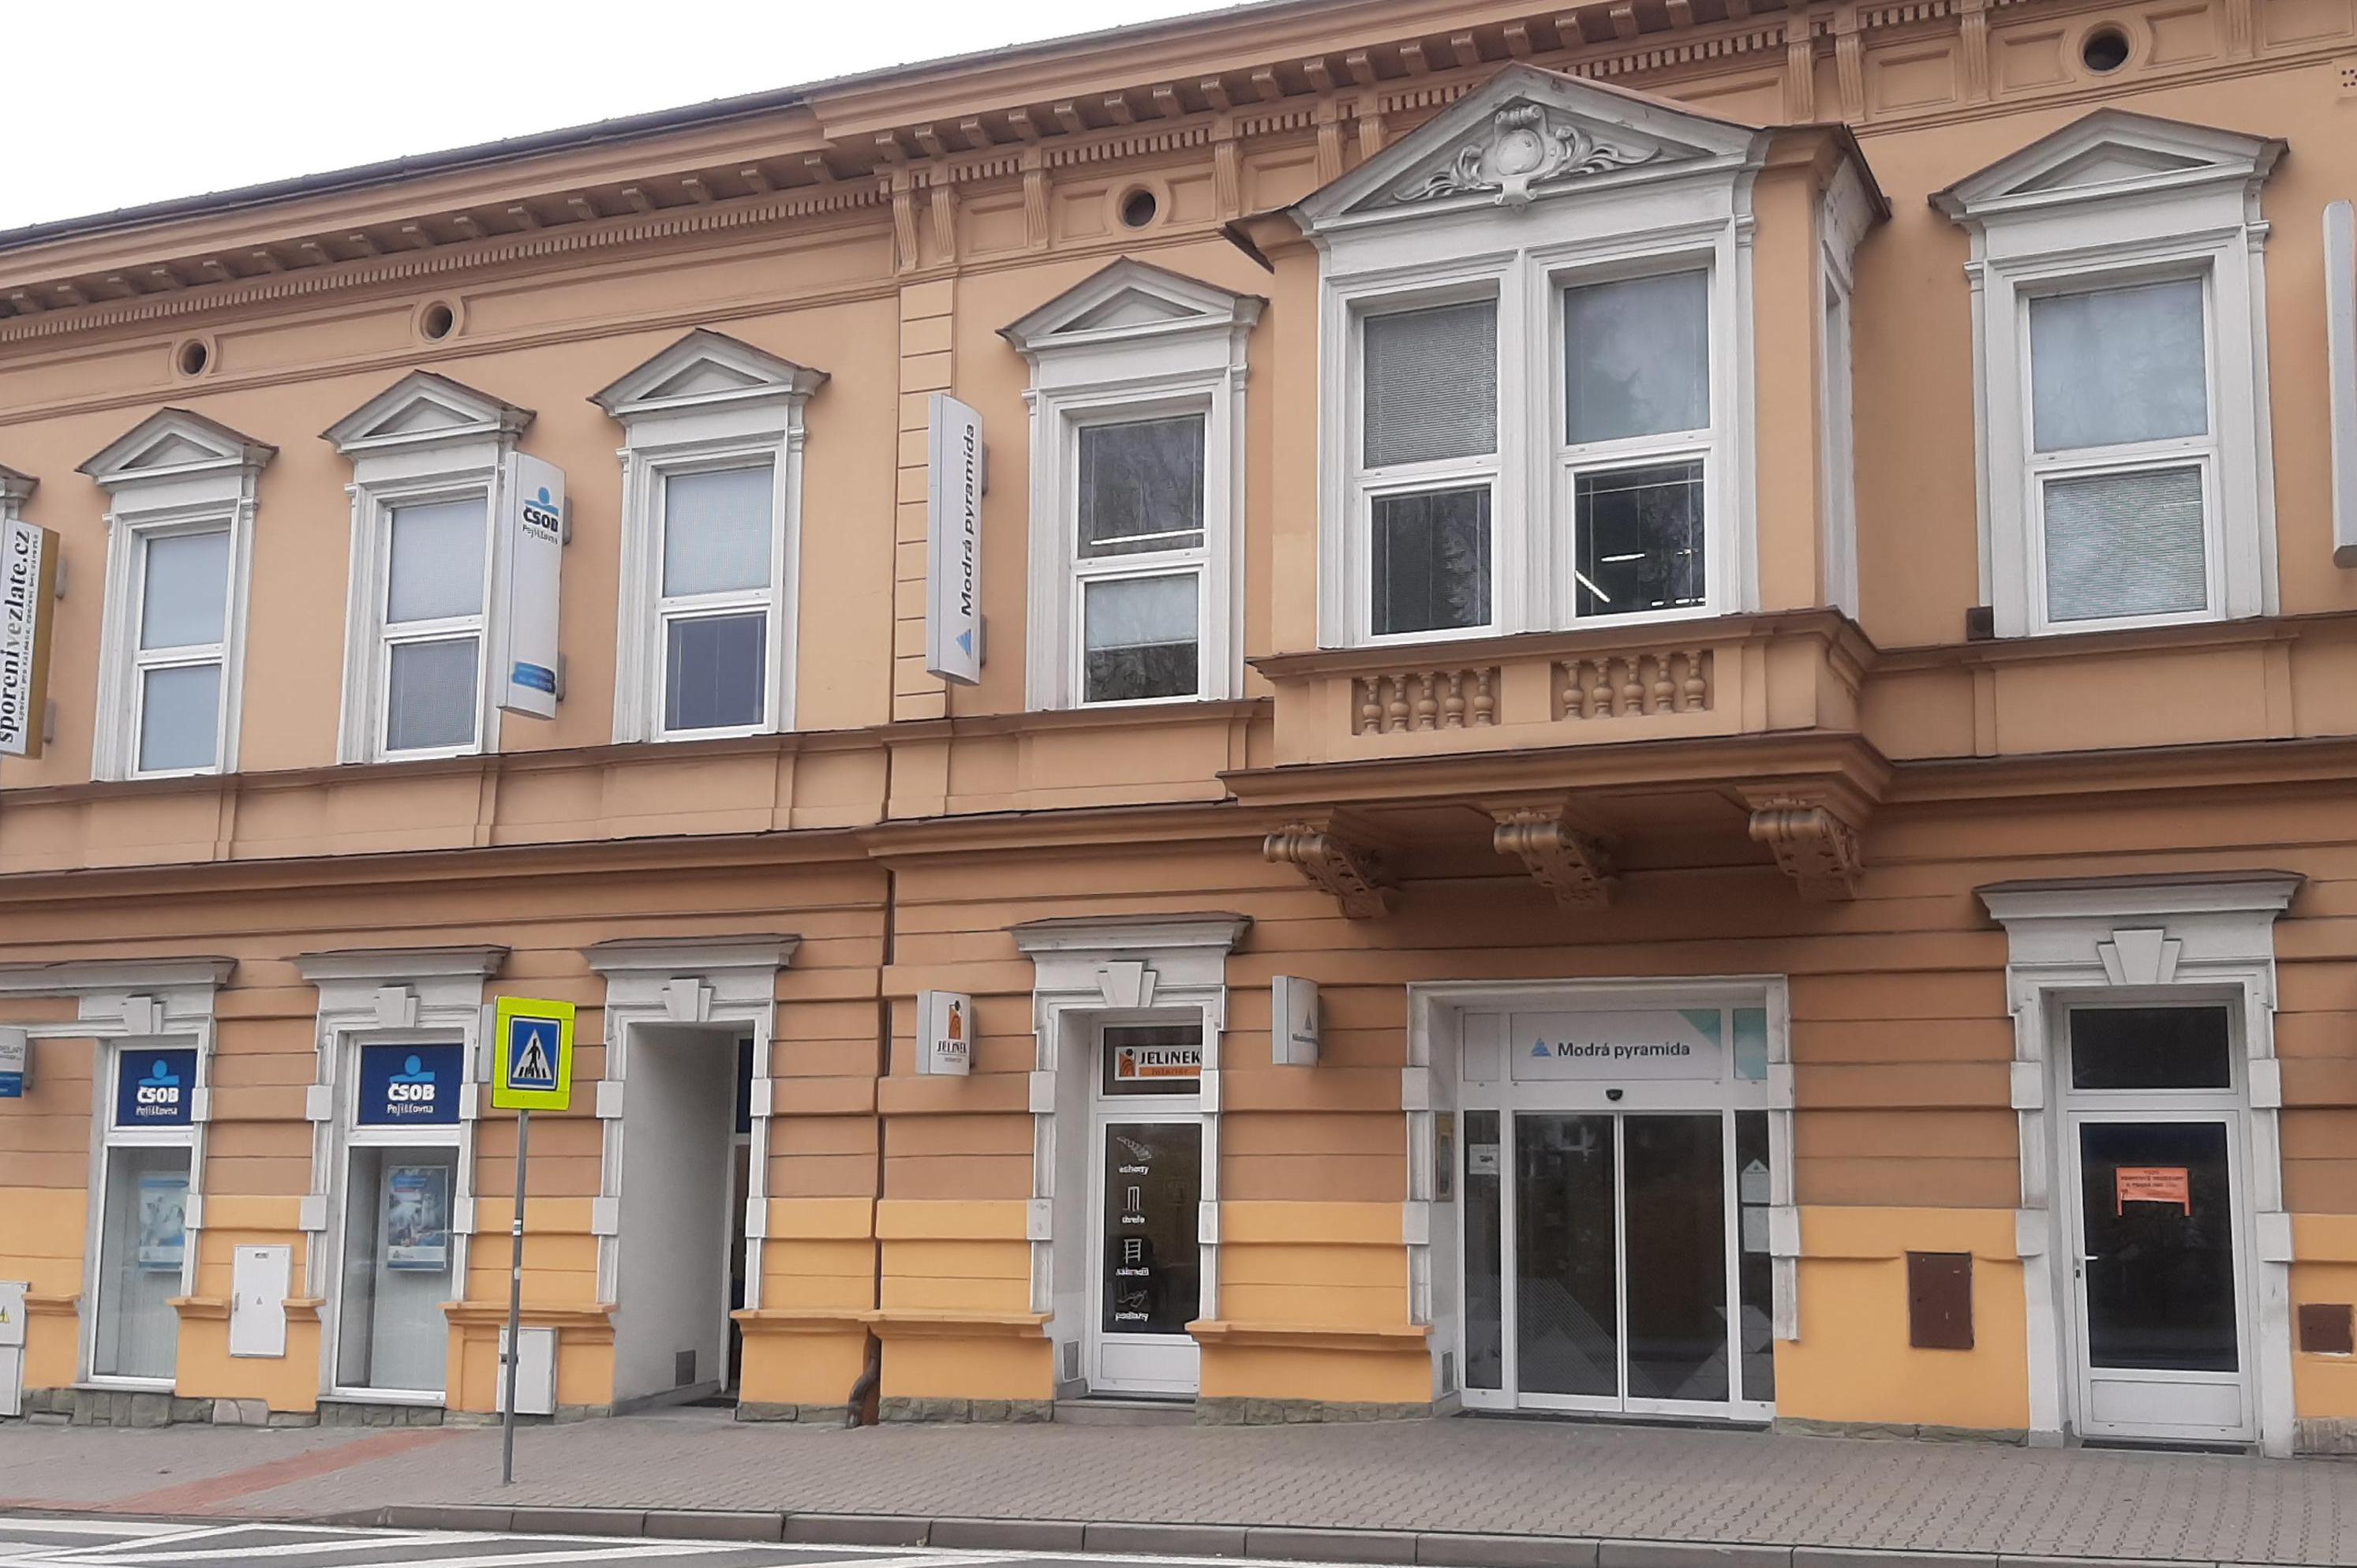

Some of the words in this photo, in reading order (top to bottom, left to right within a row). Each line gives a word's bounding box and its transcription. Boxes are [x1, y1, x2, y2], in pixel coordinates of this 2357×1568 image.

[963, 425, 975, 535] pyramida
[962, 539, 972, 617] Modrá
[0, 530, 30, 743] sporenivezlate.cz
[1558, 1042, 1611, 1057] Modrá
[1614, 1042, 1690, 1059] pyramida
[137, 1086, 179, 1103] ČSOB
[388, 1083, 435, 1101] ČSOB
